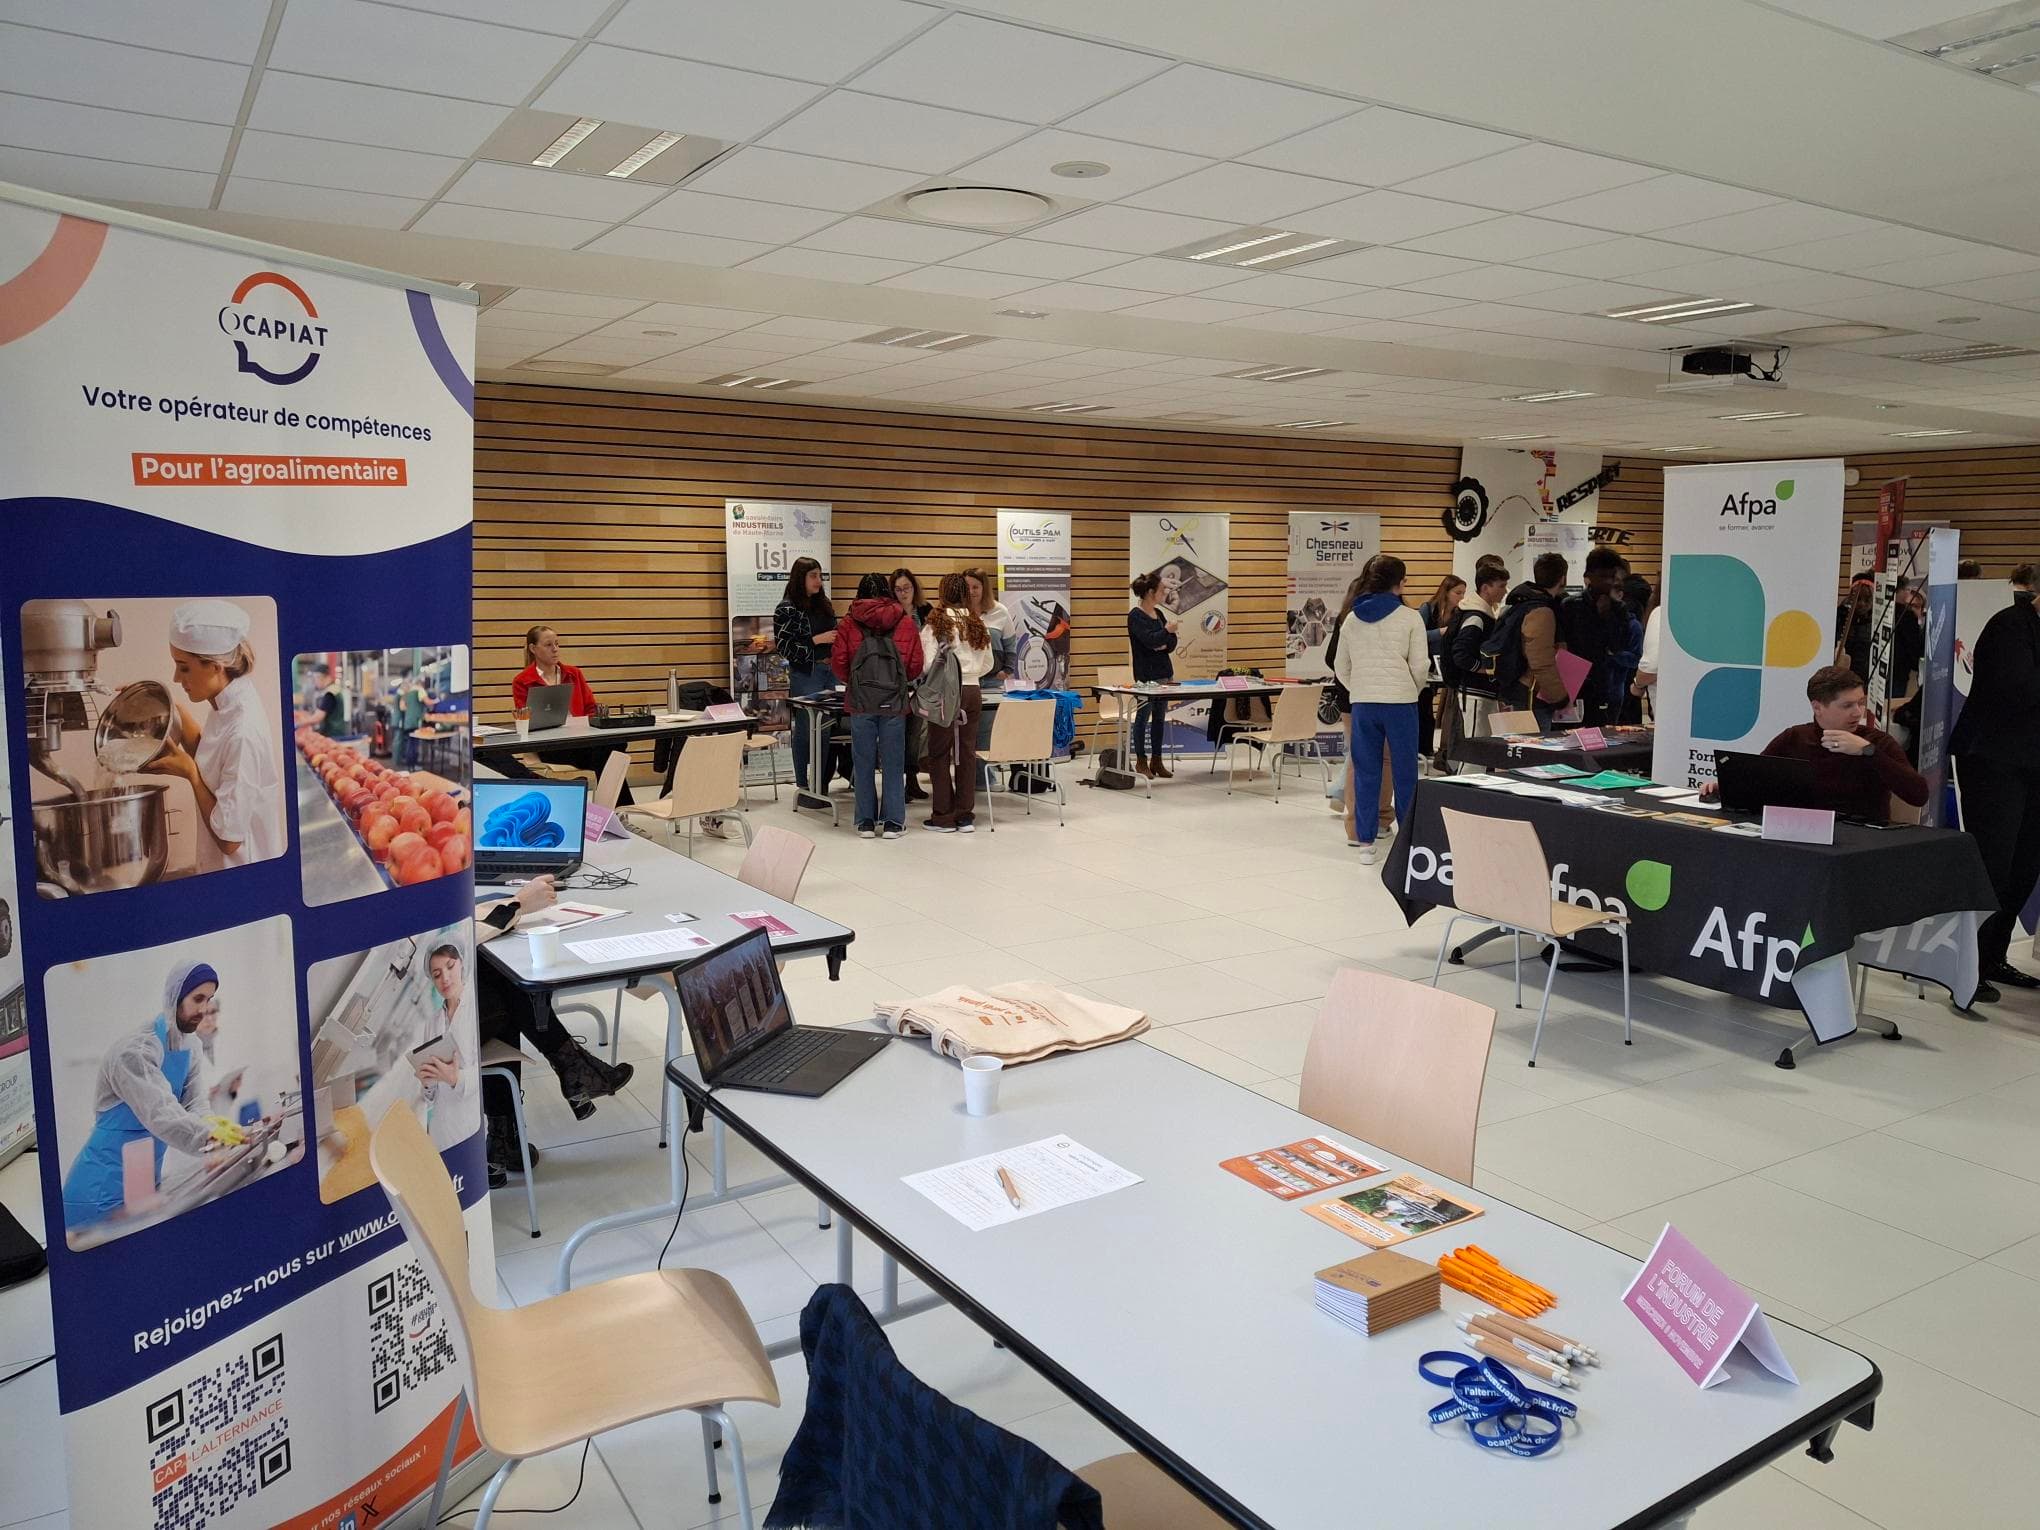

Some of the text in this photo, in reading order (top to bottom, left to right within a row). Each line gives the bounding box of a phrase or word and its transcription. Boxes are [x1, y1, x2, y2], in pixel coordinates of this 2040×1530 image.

[82, 385, 432, 442] Votre opérateur de compétences
[141, 457, 398, 484] Pour l'agroalimentaire
[1720, 492, 1777, 523] Afpa
[732, 521, 784, 530] INDUSTRIELS
[1012, 528, 1061, 537] OUTILS PAM
[1306, 537, 1364, 550] Chesneau
[1316, 550, 1354, 562] Serret
[134, 1257, 301, 1354] Rejoignez-nous
[306, 1240, 335, 1265] sur
[1661, 1259, 1725, 1327] FORUM DE
[155, 1398, 283, 1484] CAP L'ALTERNANCE
[321, 1508, 341, 1528] nos
[343, 1479, 383, 1512] réseaux
[385, 1452, 421, 1482] sociaux
